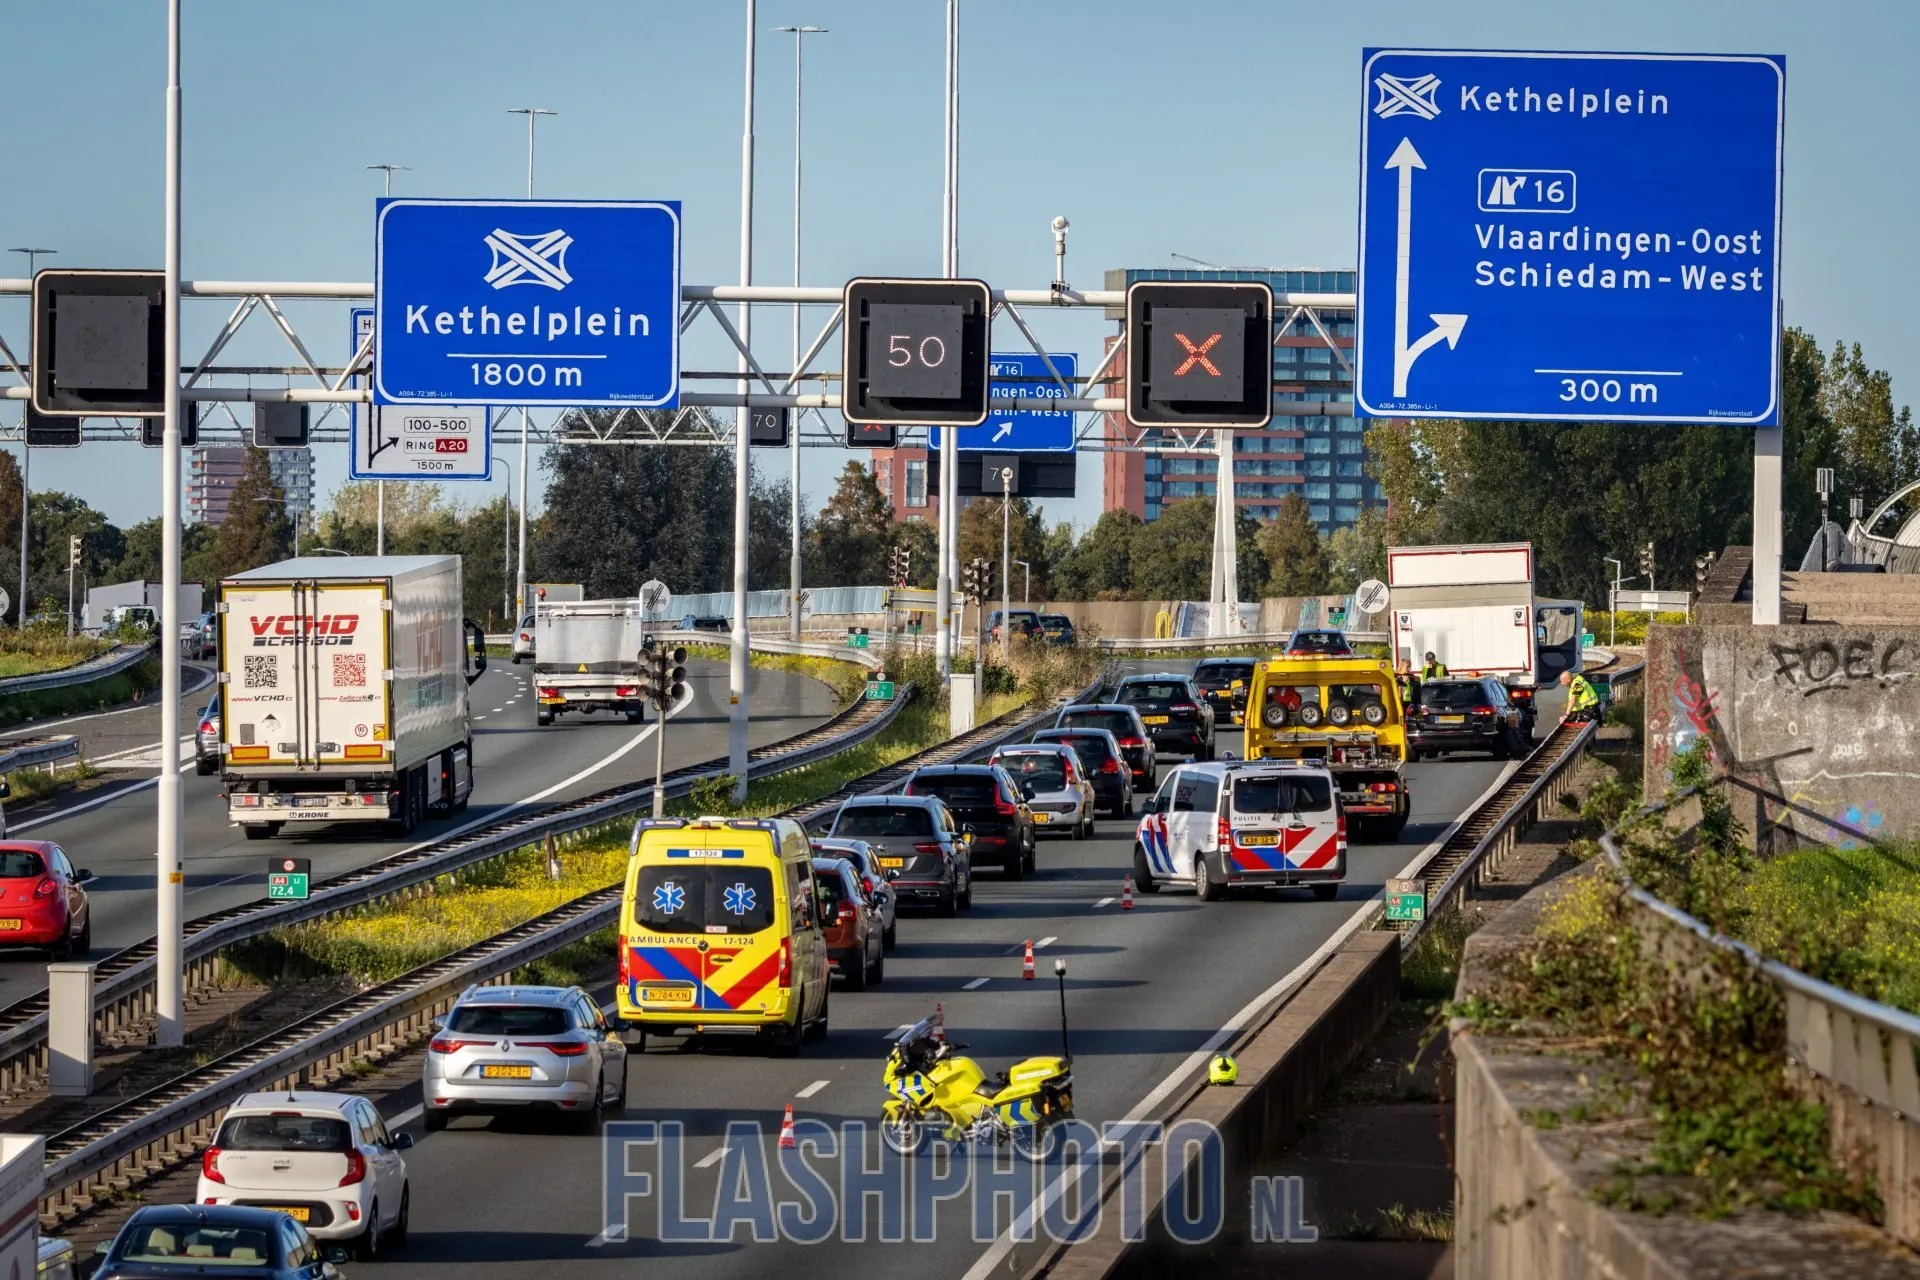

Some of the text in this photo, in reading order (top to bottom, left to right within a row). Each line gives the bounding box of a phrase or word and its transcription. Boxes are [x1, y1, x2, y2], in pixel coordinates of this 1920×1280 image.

[1460, 85, 1669, 119] Kethelplein
[1535, 180, 1565, 203] 16
[1475, 223, 1762, 260] Vlaardingen-Oost
[1475, 260, 1764, 292] Schiedam-West
[405, 304, 650, 342] Kethelplein
[888, 335, 945, 368] 50
[471, 363, 582, 387] 1800 m
[1005, 366, 1018, 376] 16
[992, 385, 1068, 398] ngen-Oost
[1559, 379, 1658, 403] 300 m
[1708, 409, 1753, 417] Rijkswaterstaat
[408, 419, 467, 431] 100-500
[753, 414, 777, 428] 70
[406, 441, 466, 451] RING A20
[417, 462, 442, 470] 1500
[990, 467, 999, 481] 7
[271, 886, 294, 897] 72,4
[629, 936, 698, 945] AMBULANCE
[723, 937, 755, 946] 17-124
[649, 990, 688, 1000] N-784-KN
